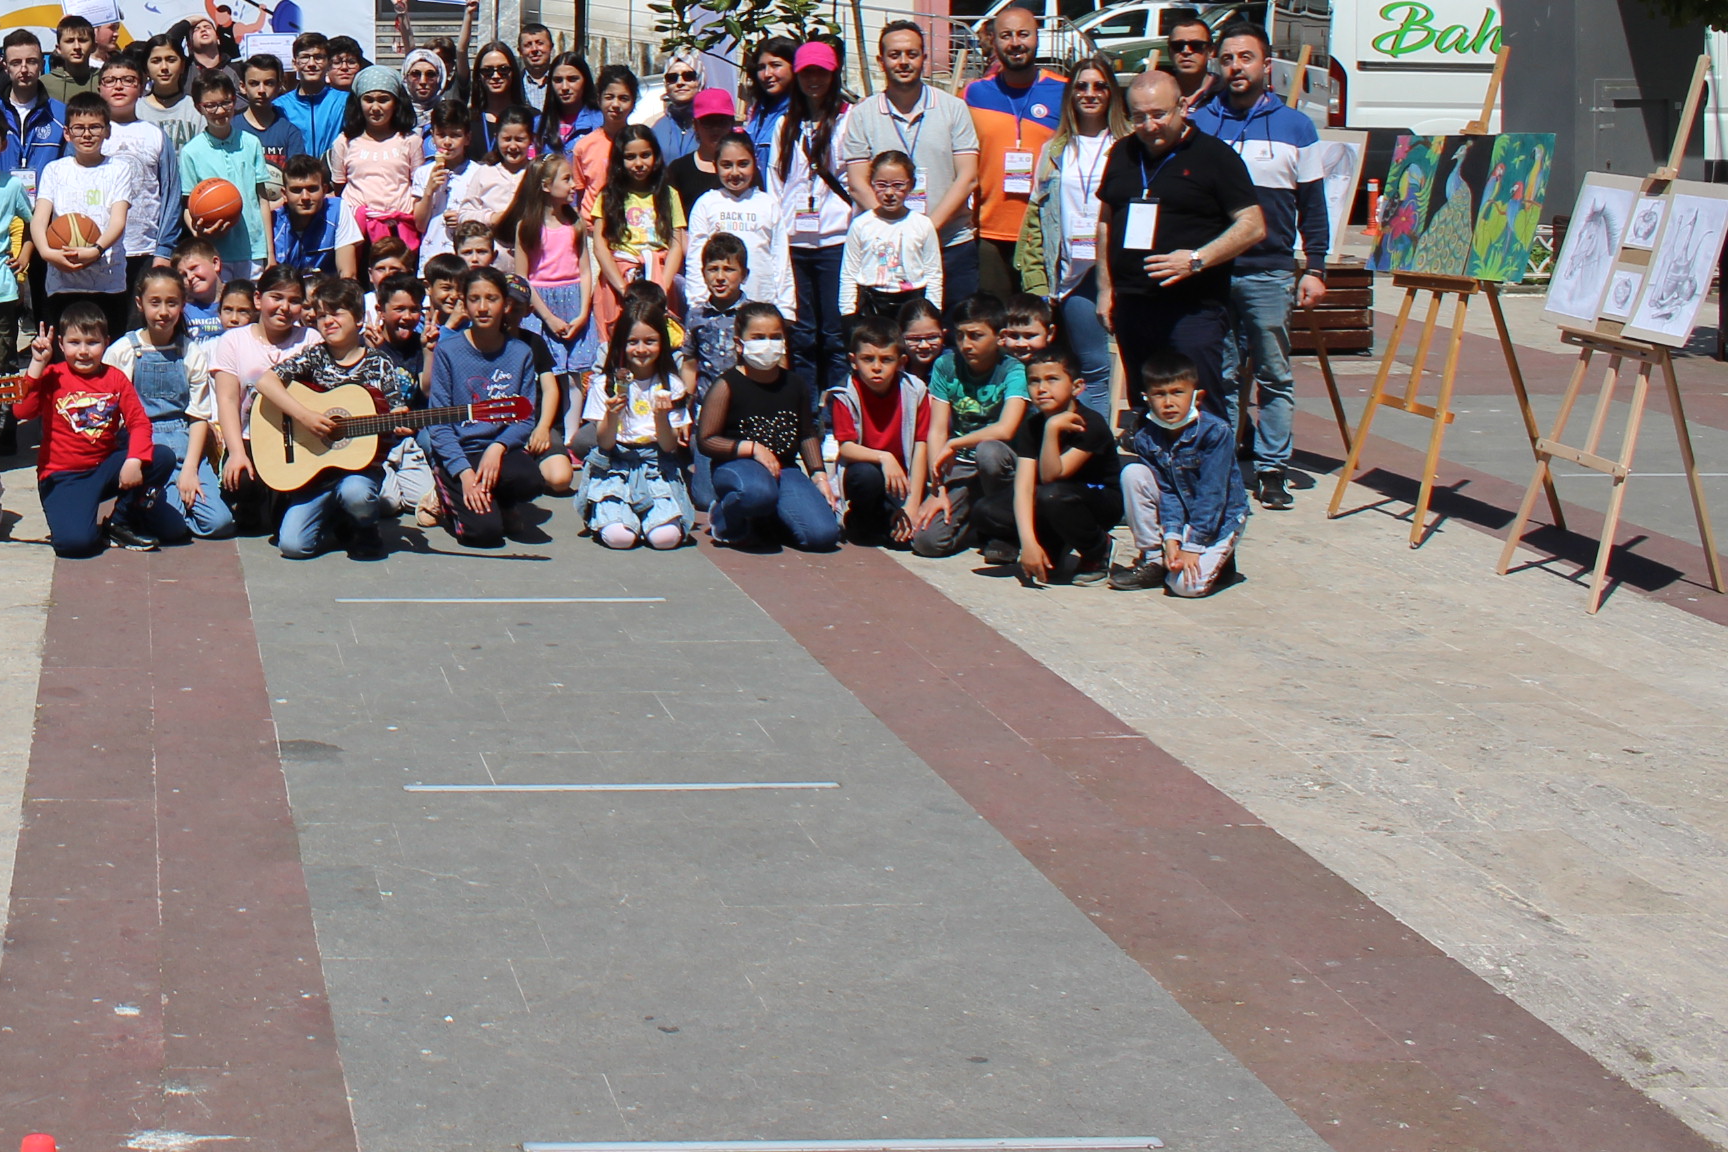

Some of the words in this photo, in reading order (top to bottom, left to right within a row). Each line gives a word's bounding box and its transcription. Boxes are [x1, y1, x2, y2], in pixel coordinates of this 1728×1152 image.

[720, 211, 743, 221] BACK
[746, 212, 757, 222] TO
[188, 316, 222, 326] ORIGIN
